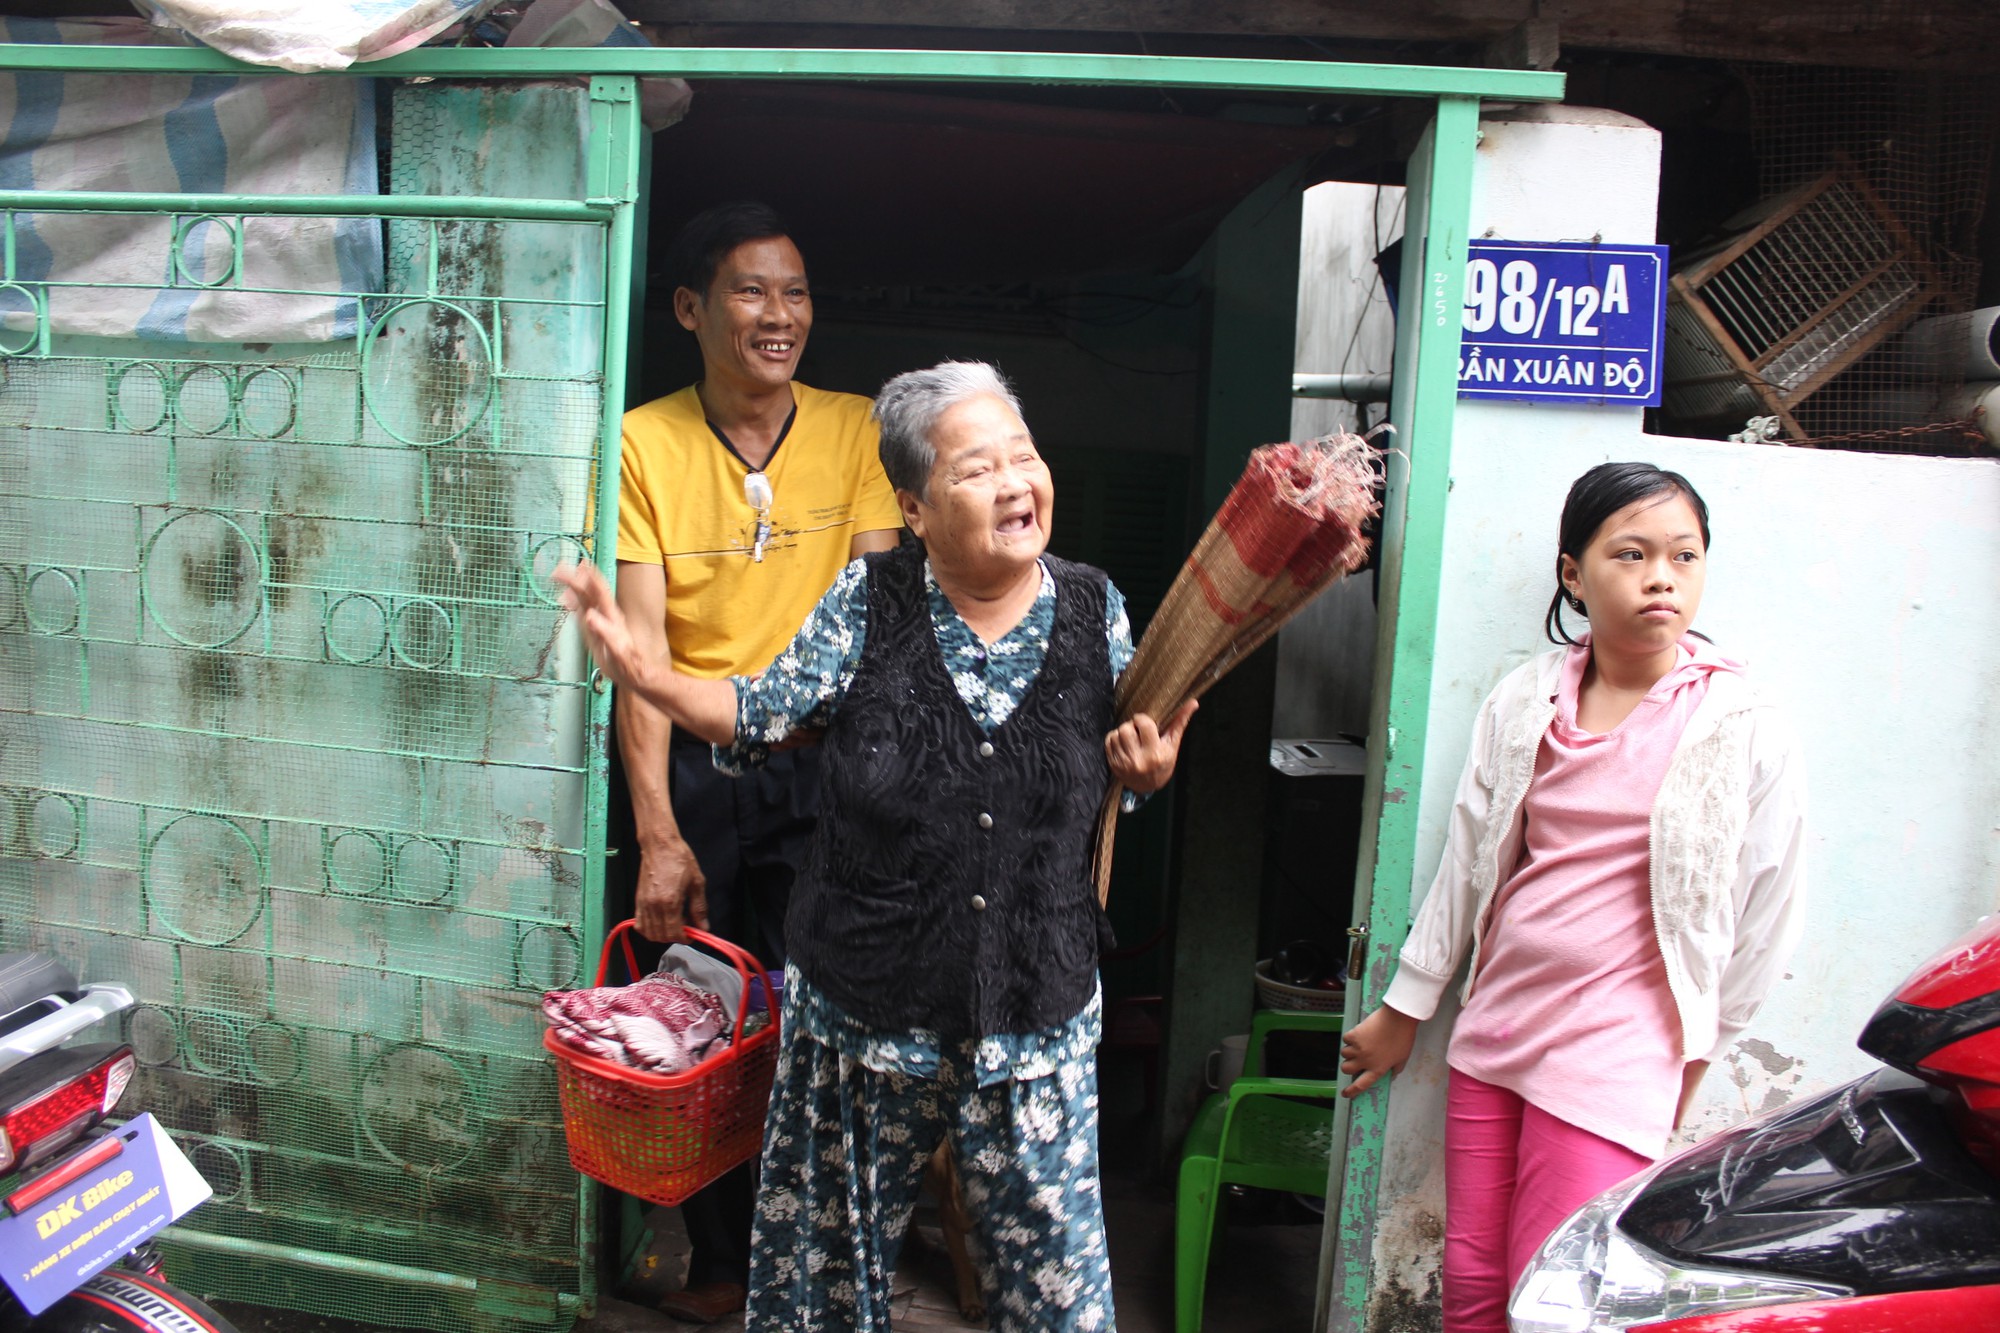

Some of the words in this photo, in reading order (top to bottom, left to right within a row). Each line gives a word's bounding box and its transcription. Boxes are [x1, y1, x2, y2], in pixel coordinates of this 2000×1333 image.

[1457, 346, 1506, 382] ẦN
[1512, 354, 1595, 385] XUÂN
[1603, 357, 1645, 393] ĐỘ
[36, 1194, 83, 1240] DK
[80, 1169, 134, 1211] Bike
